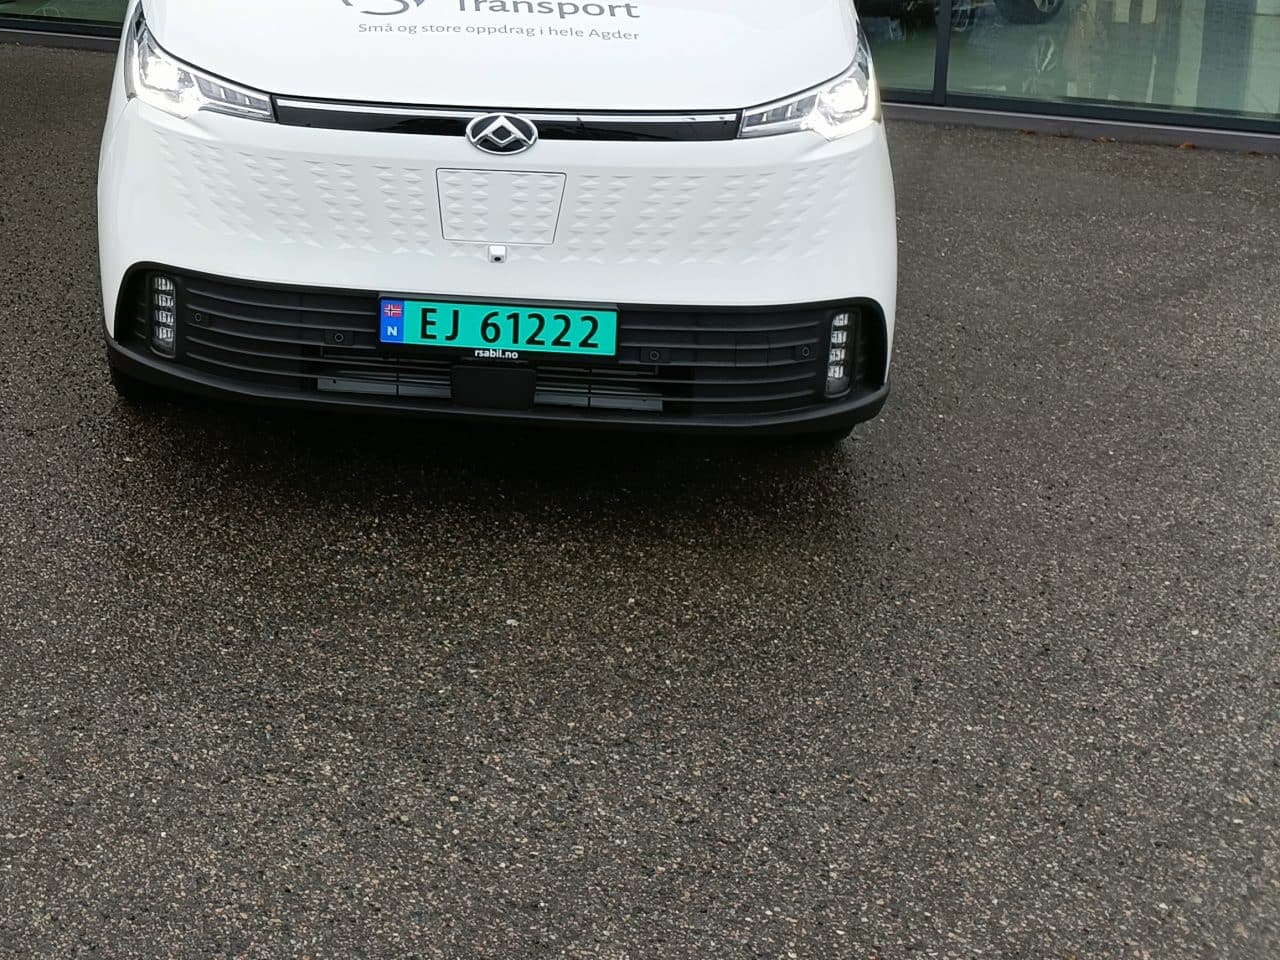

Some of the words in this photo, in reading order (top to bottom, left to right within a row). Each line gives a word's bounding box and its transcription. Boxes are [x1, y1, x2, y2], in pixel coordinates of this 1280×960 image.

[358, 22, 393, 33] Små
[397, 24, 417, 35] og
[421, 23, 461, 33] store
[466, 23, 535, 37] oppdrag
[548, 27, 584, 38] hele
[588, 28, 640, 41] Agder
[387, 326, 397, 336] N
[421, 307, 460, 342] EJ
[480, 311, 600, 349] 61222
[474, 348, 519, 360] rsabil.no
